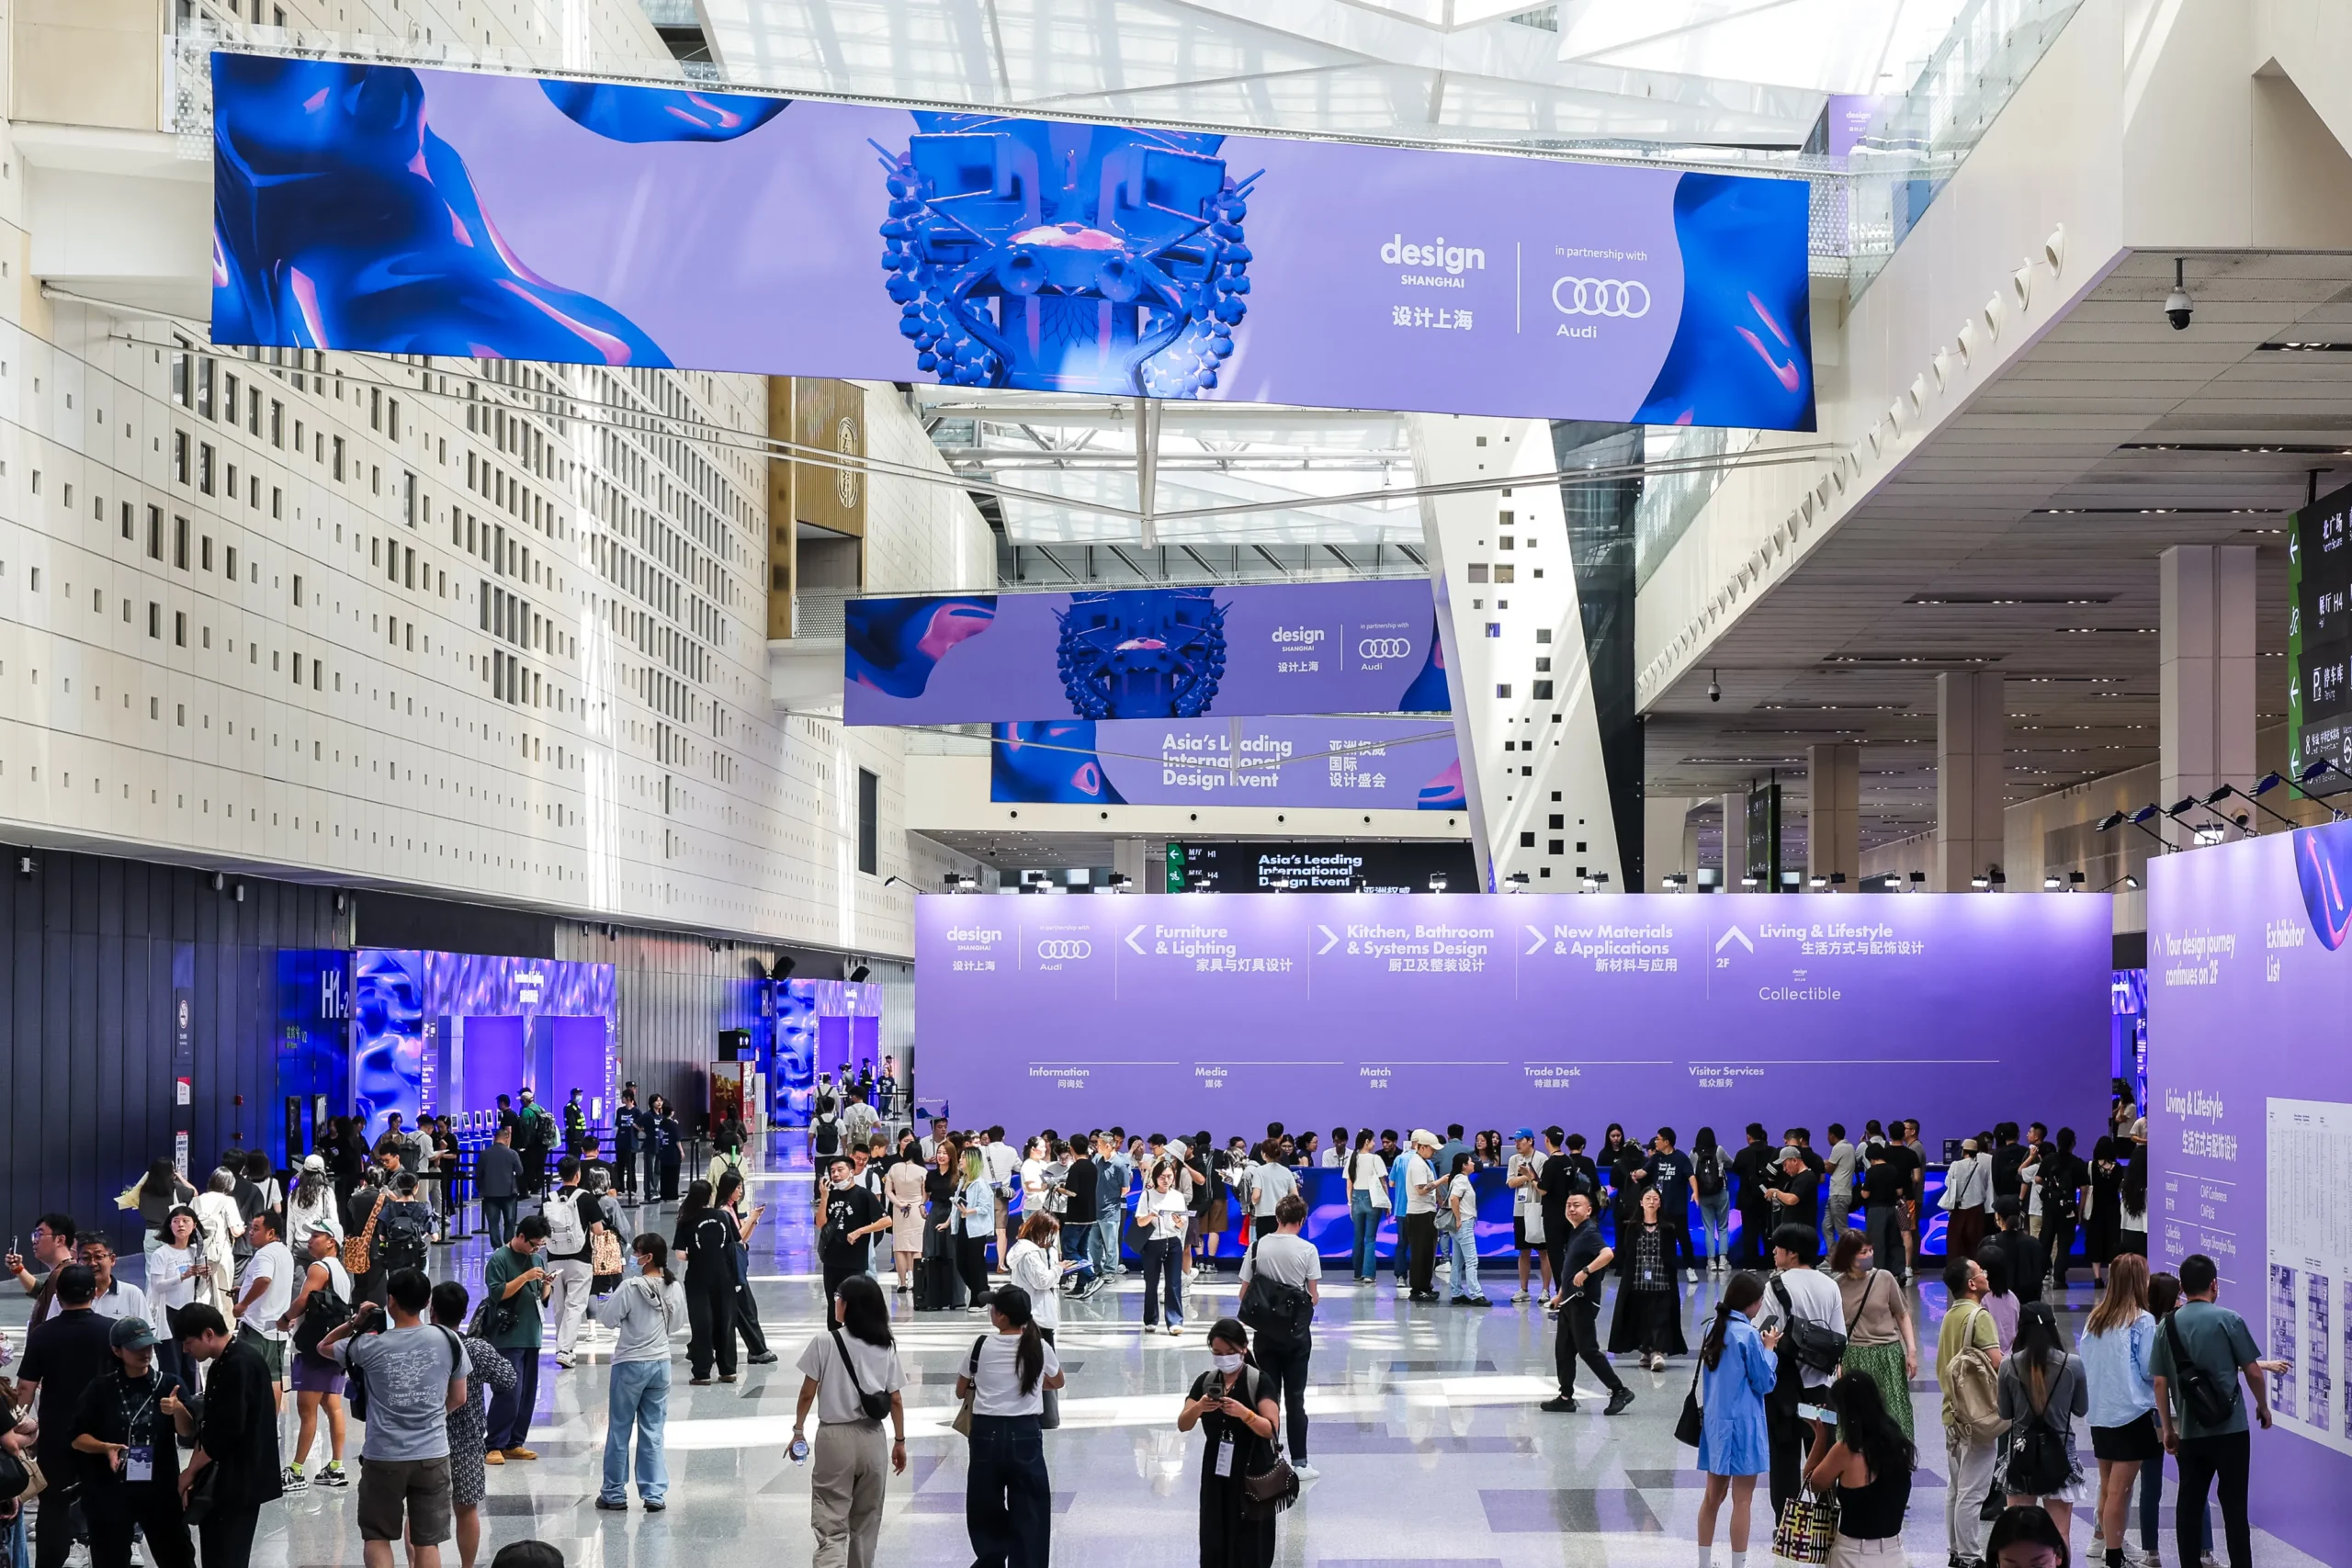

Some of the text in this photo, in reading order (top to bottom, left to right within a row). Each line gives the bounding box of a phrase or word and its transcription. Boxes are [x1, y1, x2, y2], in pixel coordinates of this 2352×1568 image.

[1380, 233, 1485, 274] design
[1555, 245, 1647, 262] in partnership with
[1401, 275, 1464, 288] SHANGHAI
[1392, 306, 1473, 331] 设计上海
[1556, 324, 1597, 338] Audi
[2323, 513, 2343, 539] 北广场
[2319, 592, 2343, 615] 展厅 H4
[1272, 626, 1324, 644] design
[1366, 623, 1396, 631] partnership
[1278, 660, 1319, 672] 设计上海
[1361, 662, 1383, 671] Audi
[2324, 663, 2344, 688] 停车库
[1162, 733, 1292, 757] Asia's Lading
[2305, 735, 2311, 755] 8
[1163, 751, 1281, 770] Internaonal
[1329, 756, 1358, 772] 国际
[1163, 769, 1225, 791] Design
[1329, 772, 1386, 788] 设计盛会
[1259, 854, 1363, 867] Asia's Leading
[1259, 865, 1352, 875] International
[1311, 877, 1350, 886] Event
[946, 925, 1002, 942] design
[1155, 924, 1228, 939] Furniture
[1346, 924, 1495, 941] Kitchen, Bathroom
[1554, 923, 1674, 939] New Materials
[1759, 922, 1894, 942] Living & Lifestyle
[2266, 919, 2305, 949] Exhibitor
[1155, 941, 1237, 958] & Lighting
[1346, 941, 1487, 958] & Systems Design
[1554, 941, 1669, 958] & Applications
[1801, 941, 1925, 955] 生活方式与配饰设计
[2165, 927, 2236, 961] Your design journey
[952, 960, 996, 972] 设计上海
[1039, 963, 1062, 971] Audi
[1195, 957, 1293, 973] 家具与灯具设计
[1388, 958, 1485, 973] 厨卫及整装设计
[1594, 958, 1679, 973] 新材料与应用
[1715, 957, 1730, 969] 2F
[2267, 954, 2280, 982] List
[2165, 959, 2219, 987] continues on 2F
[1758, 987, 1841, 1001] Collectible
[1029, 1067, 1091, 1077] Information
[1194, 1066, 1227, 1077] Media
[1360, 1066, 1392, 1077] Match
[1523, 1066, 1581, 1077] Trade Desk
[1688, 1066, 1765, 1077] Visitor Services
[1057, 1078, 1084, 1089] 问询处
[1204, 1078, 1223, 1089] 媒体
[1698, 1077, 1734, 1089] 观众服务
[2165, 1089, 2223, 1125] Living & Lifestyle
[2182, 1129, 2237, 1162] 生活方式与配饰设计
[2165, 1239, 2176, 1257] Design
[2200, 1233, 2237, 1258] Design Shanghai Shop
